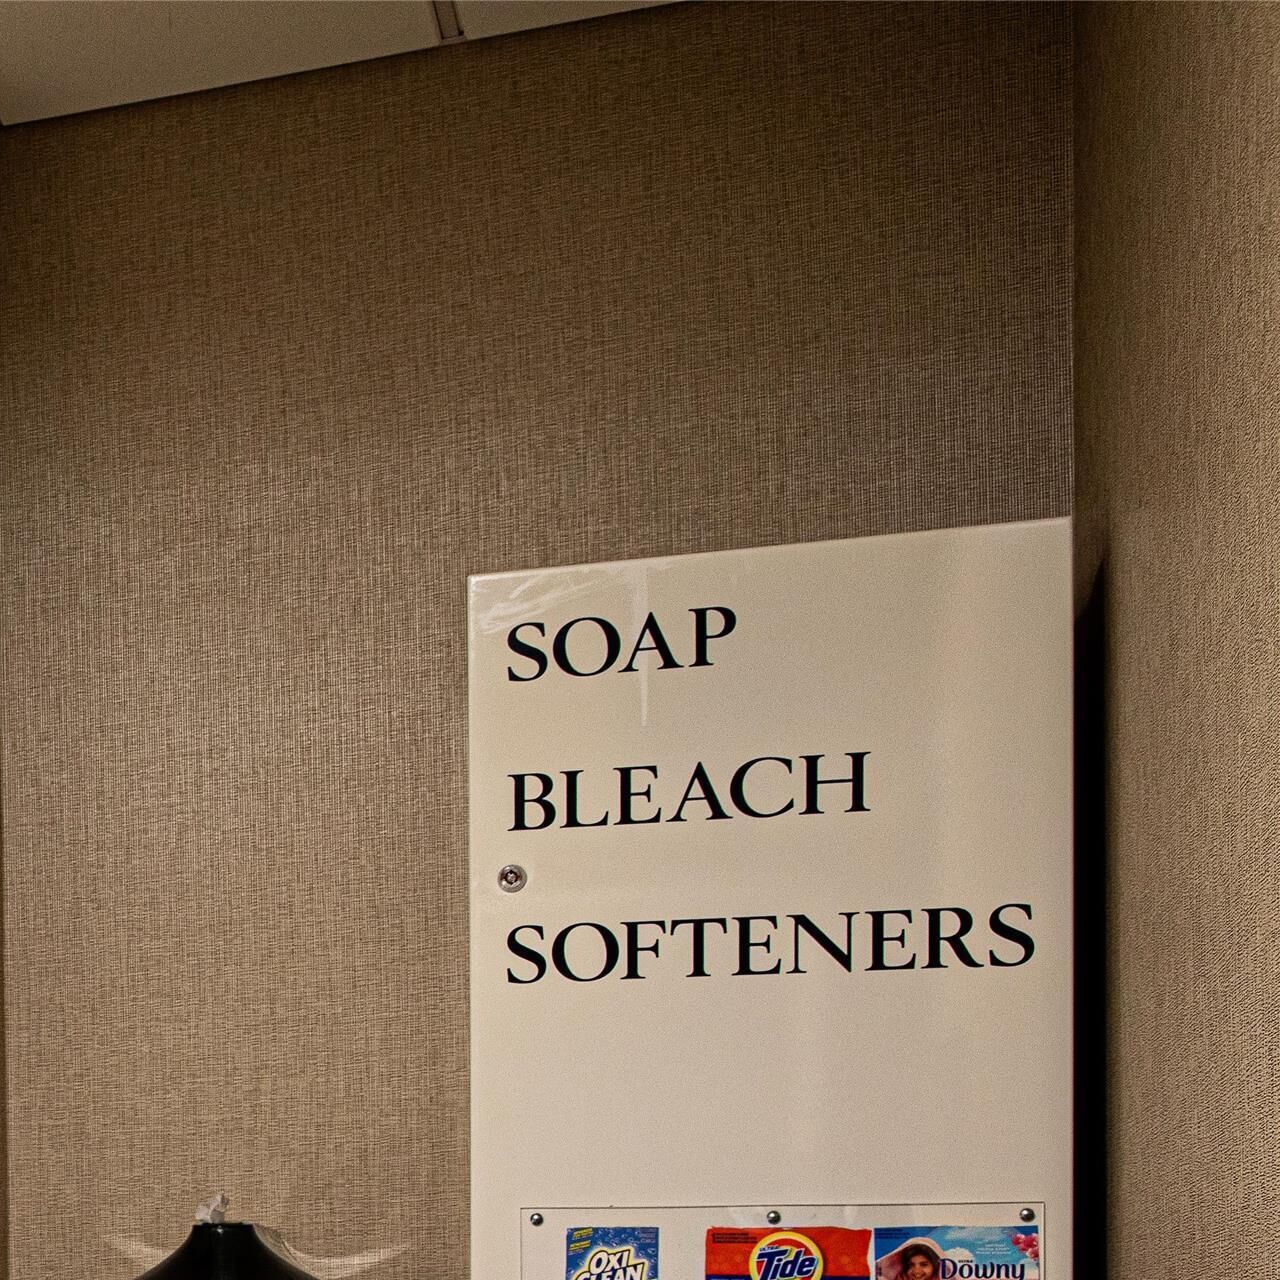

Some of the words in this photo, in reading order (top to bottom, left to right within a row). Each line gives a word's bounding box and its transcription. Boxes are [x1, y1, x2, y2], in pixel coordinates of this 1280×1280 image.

[507, 606, 737, 682] SOAP
[507, 751, 871, 831] BLEACH
[506, 903, 1035, 984] SOFTENERS
[589, 1249, 631, 1274] OXI
